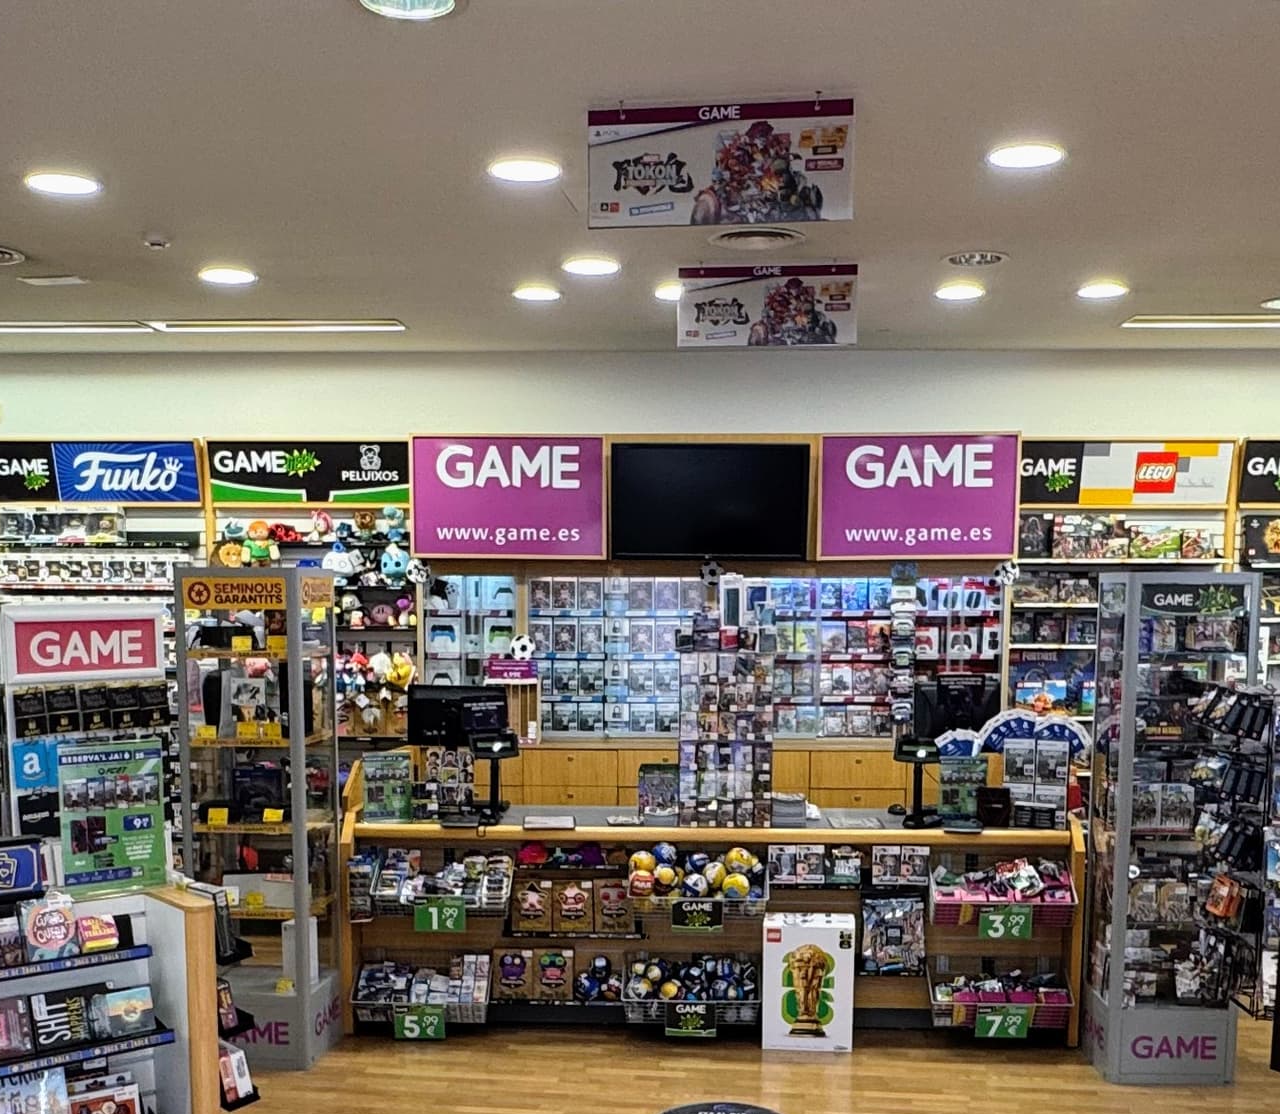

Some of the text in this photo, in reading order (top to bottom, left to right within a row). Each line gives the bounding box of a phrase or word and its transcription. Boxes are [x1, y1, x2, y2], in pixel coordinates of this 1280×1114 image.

[699, 105, 741, 120] GAME
[753, 265, 782, 276] GAME
[73, 451, 183, 492] Funko
[214, 451, 286, 474] GAME
[436, 444, 580, 489] GAME
[846, 444, 994, 489] GAME
[1020, 457, 1076, 476] GAME
[1136, 463, 1174, 481] LEGO
[342, 470, 399, 482] PELUIXOS
[437, 526, 580, 546] www.game.es
[845, 525, 993, 545] www.game.es
[214, 583, 283, 594] SEMINOUS
[214, 594, 283, 605] GARANTITS
[1154, 593, 1194, 607] GAME
[30, 629, 145, 667] GAME
[23, 753, 42, 777] a
[682, 901, 713, 912] GAME
[315, 996, 341, 1034] GAME
[676, 1003, 706, 1015] GAME
[38, 1000, 71, 1045] SHIT
[1131, 1035, 1217, 1060] GAME
